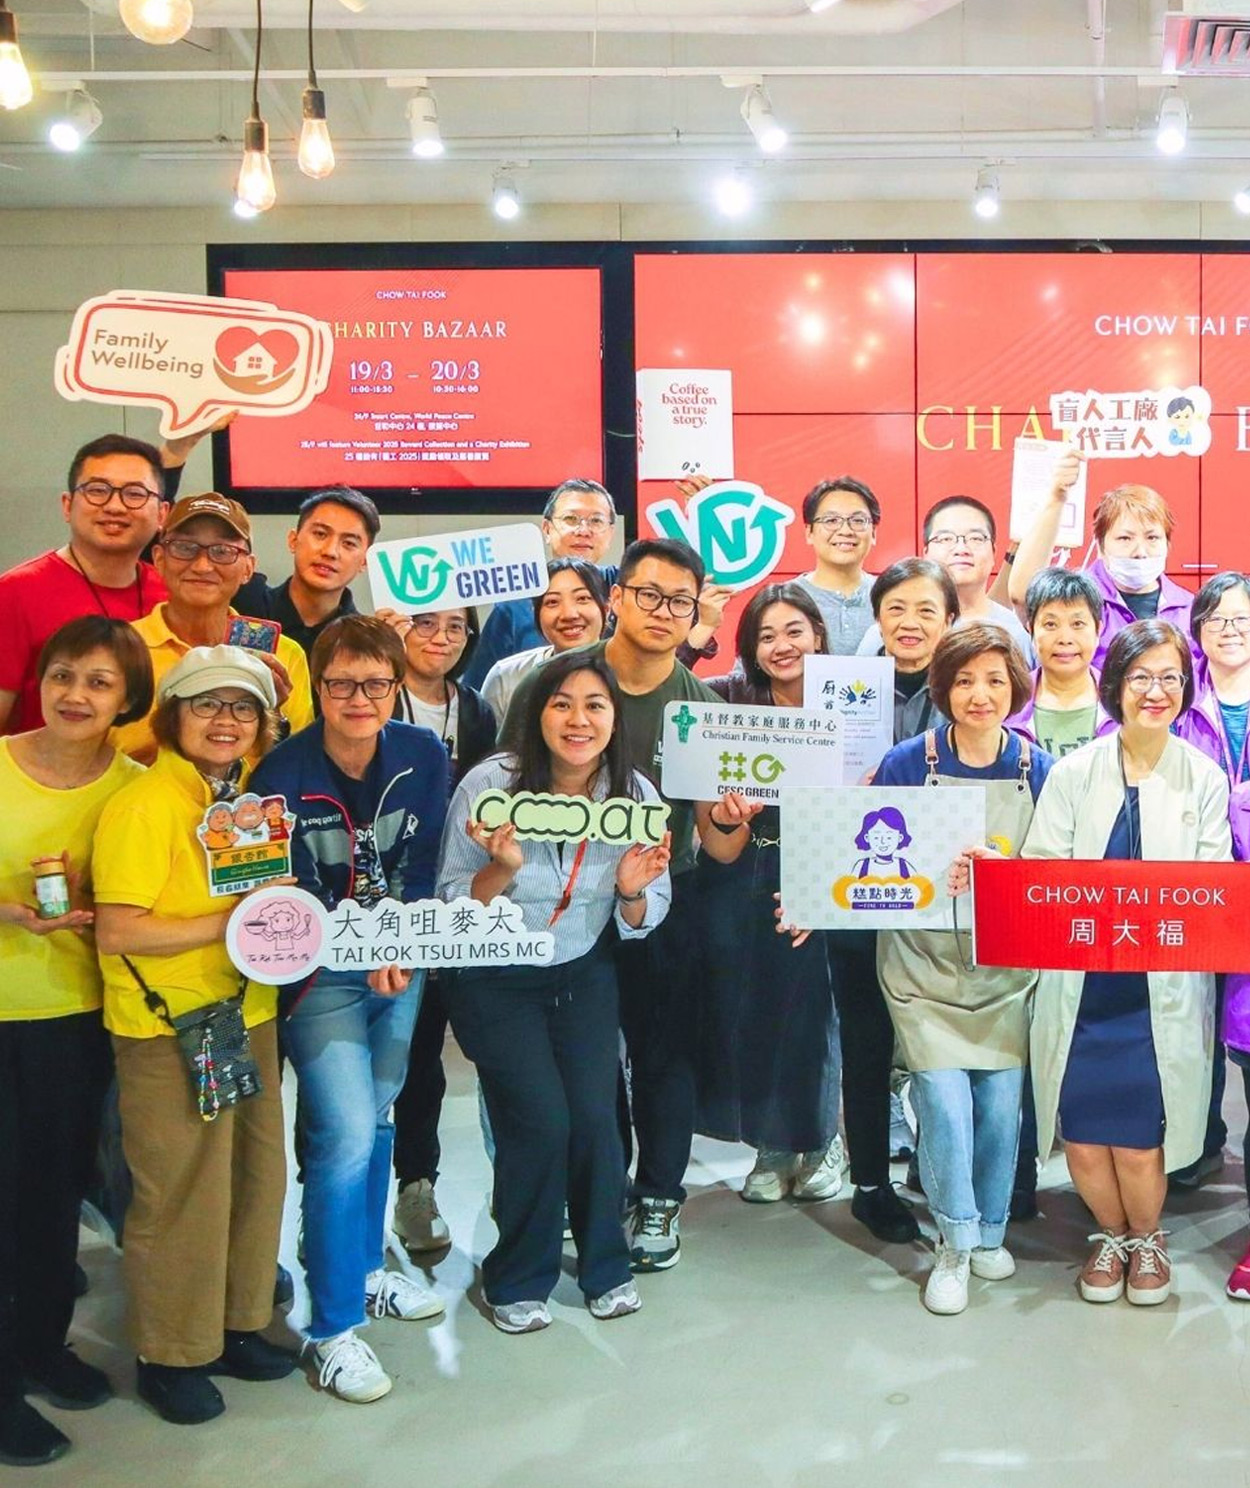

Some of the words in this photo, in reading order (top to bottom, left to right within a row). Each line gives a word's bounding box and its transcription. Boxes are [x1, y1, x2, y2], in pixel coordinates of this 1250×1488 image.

[376, 291, 404, 299] CHOW
[422, 291, 447, 299] FOOK
[423, 321, 507, 338] BAZAAR
[1094, 315, 1177, 336] CHOW
[1185, 316, 1226, 336] TAI
[94, 328, 169, 354] Family
[91, 349, 204, 379] Wellbeing
[350, 361, 393, 381] 19/3
[431, 361, 480, 380] 20/3
[669, 382, 709, 395] Coffee
[661, 393, 699, 405] based
[700, 397, 717, 405] on
[671, 406, 680, 415] a
[682, 405, 708, 415] true
[1056, 397, 1159, 423] 盲人工廠
[672, 415, 708, 429] story.
[1076, 425, 1154, 451] 代言人
[451, 536, 495, 567] WE
[455, 561, 541, 599] GREEN
[703, 712, 837, 732] 基督教家庭服務中心
[702, 729, 741, 741] Christian
[742, 732, 771, 745] Family
[773, 734, 805, 745] Service
[806, 736, 836, 747] Centre
[745, 786, 779, 799] GREEN
[853, 887, 913, 900] 糕點時光
[1027, 885, 1105, 905] CHOW
[1112, 887, 1149, 905] TAI
[1159, 887, 1226, 906] FOOK
[332, 905, 518, 940] 大角咀麥太
[1069, 918, 1185, 946] 周大福
[332, 946, 363, 963] TAI
[371, 945, 413, 962] KOK
[418, 943, 462, 960] TSUI
[469, 942, 510, 959] MRS
[516, 940, 546, 957] MC
